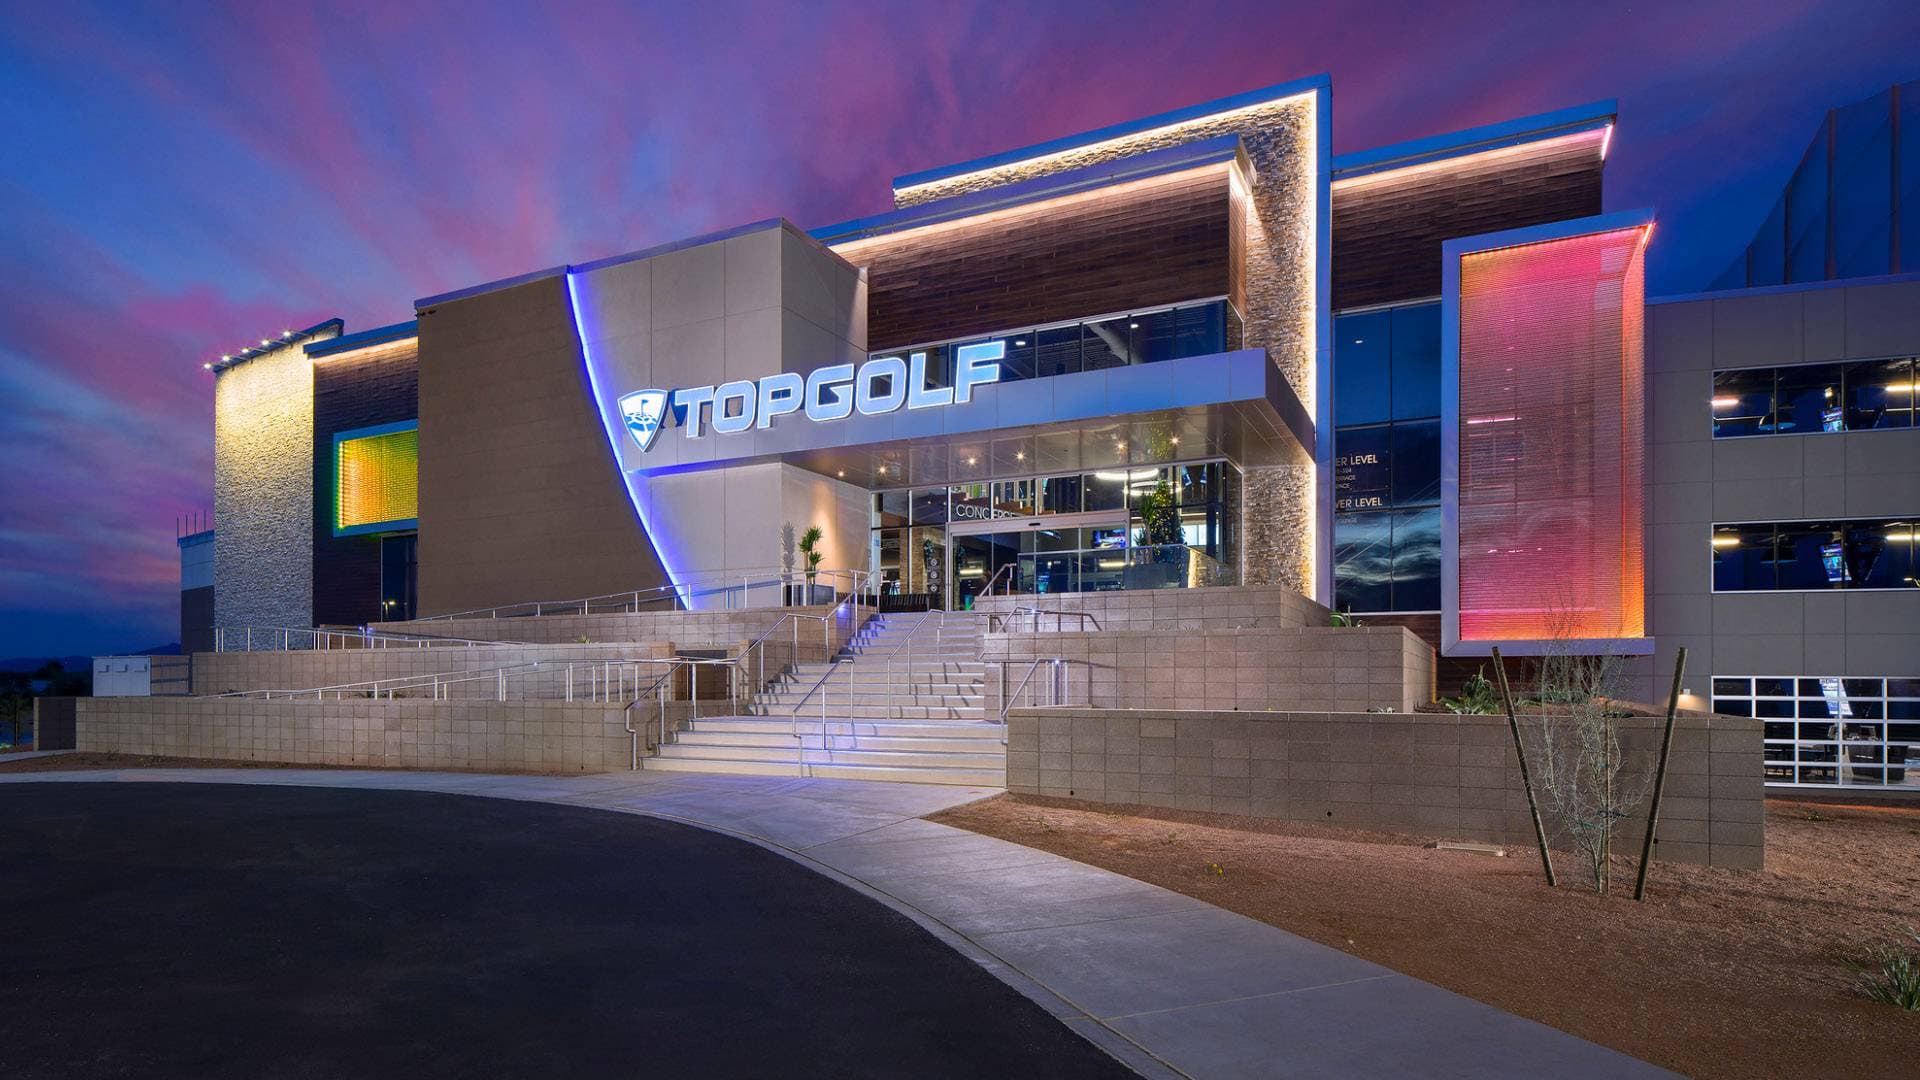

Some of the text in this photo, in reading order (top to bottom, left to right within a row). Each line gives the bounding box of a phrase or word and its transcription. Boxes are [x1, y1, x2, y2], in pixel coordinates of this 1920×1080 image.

[674, 340, 1006, 438] TOPGOLF
[1351, 454, 1378, 465] LEVEL
[1355, 497, 1382, 508] LEVEL
